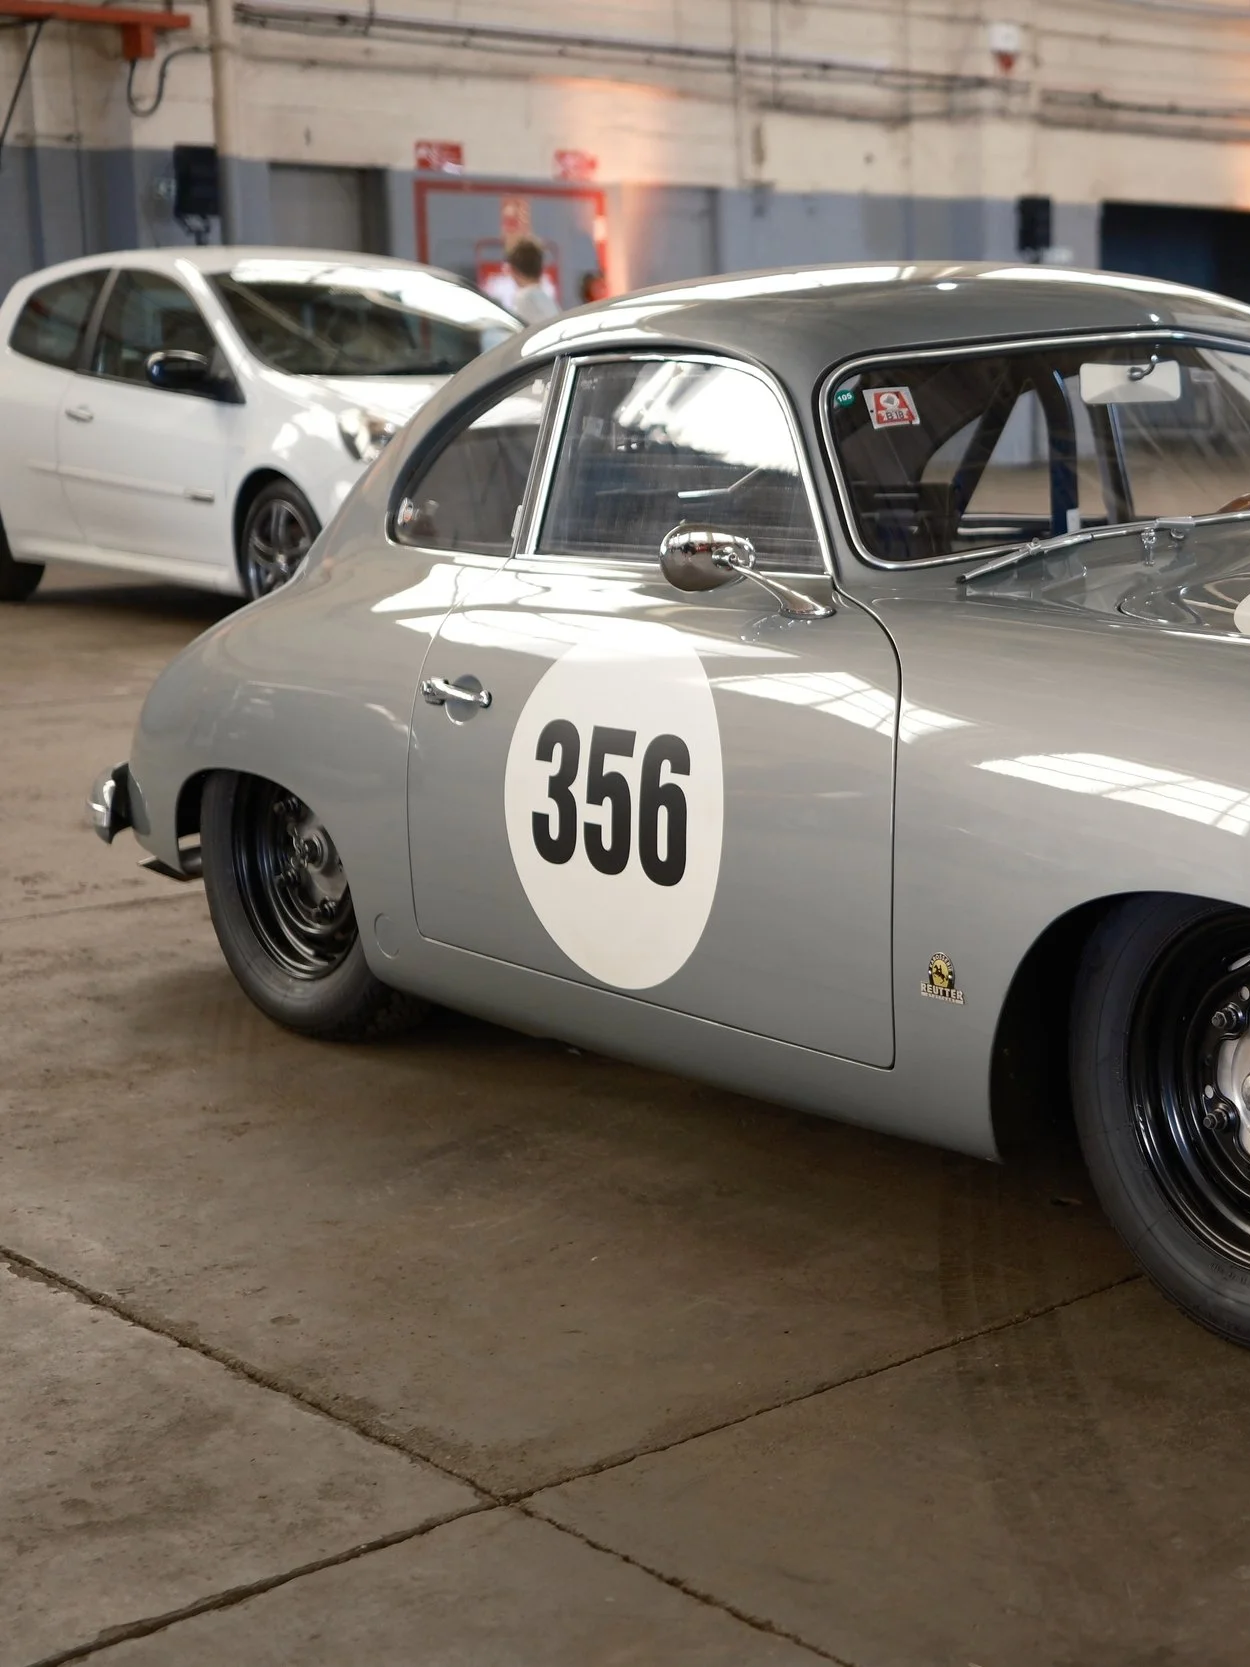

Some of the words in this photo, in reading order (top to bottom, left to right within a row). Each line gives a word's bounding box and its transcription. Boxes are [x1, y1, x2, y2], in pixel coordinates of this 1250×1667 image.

[837, 392, 853, 402] 105
[531, 718, 691, 887] 356
[920, 982, 964, 1001] REUTTER
